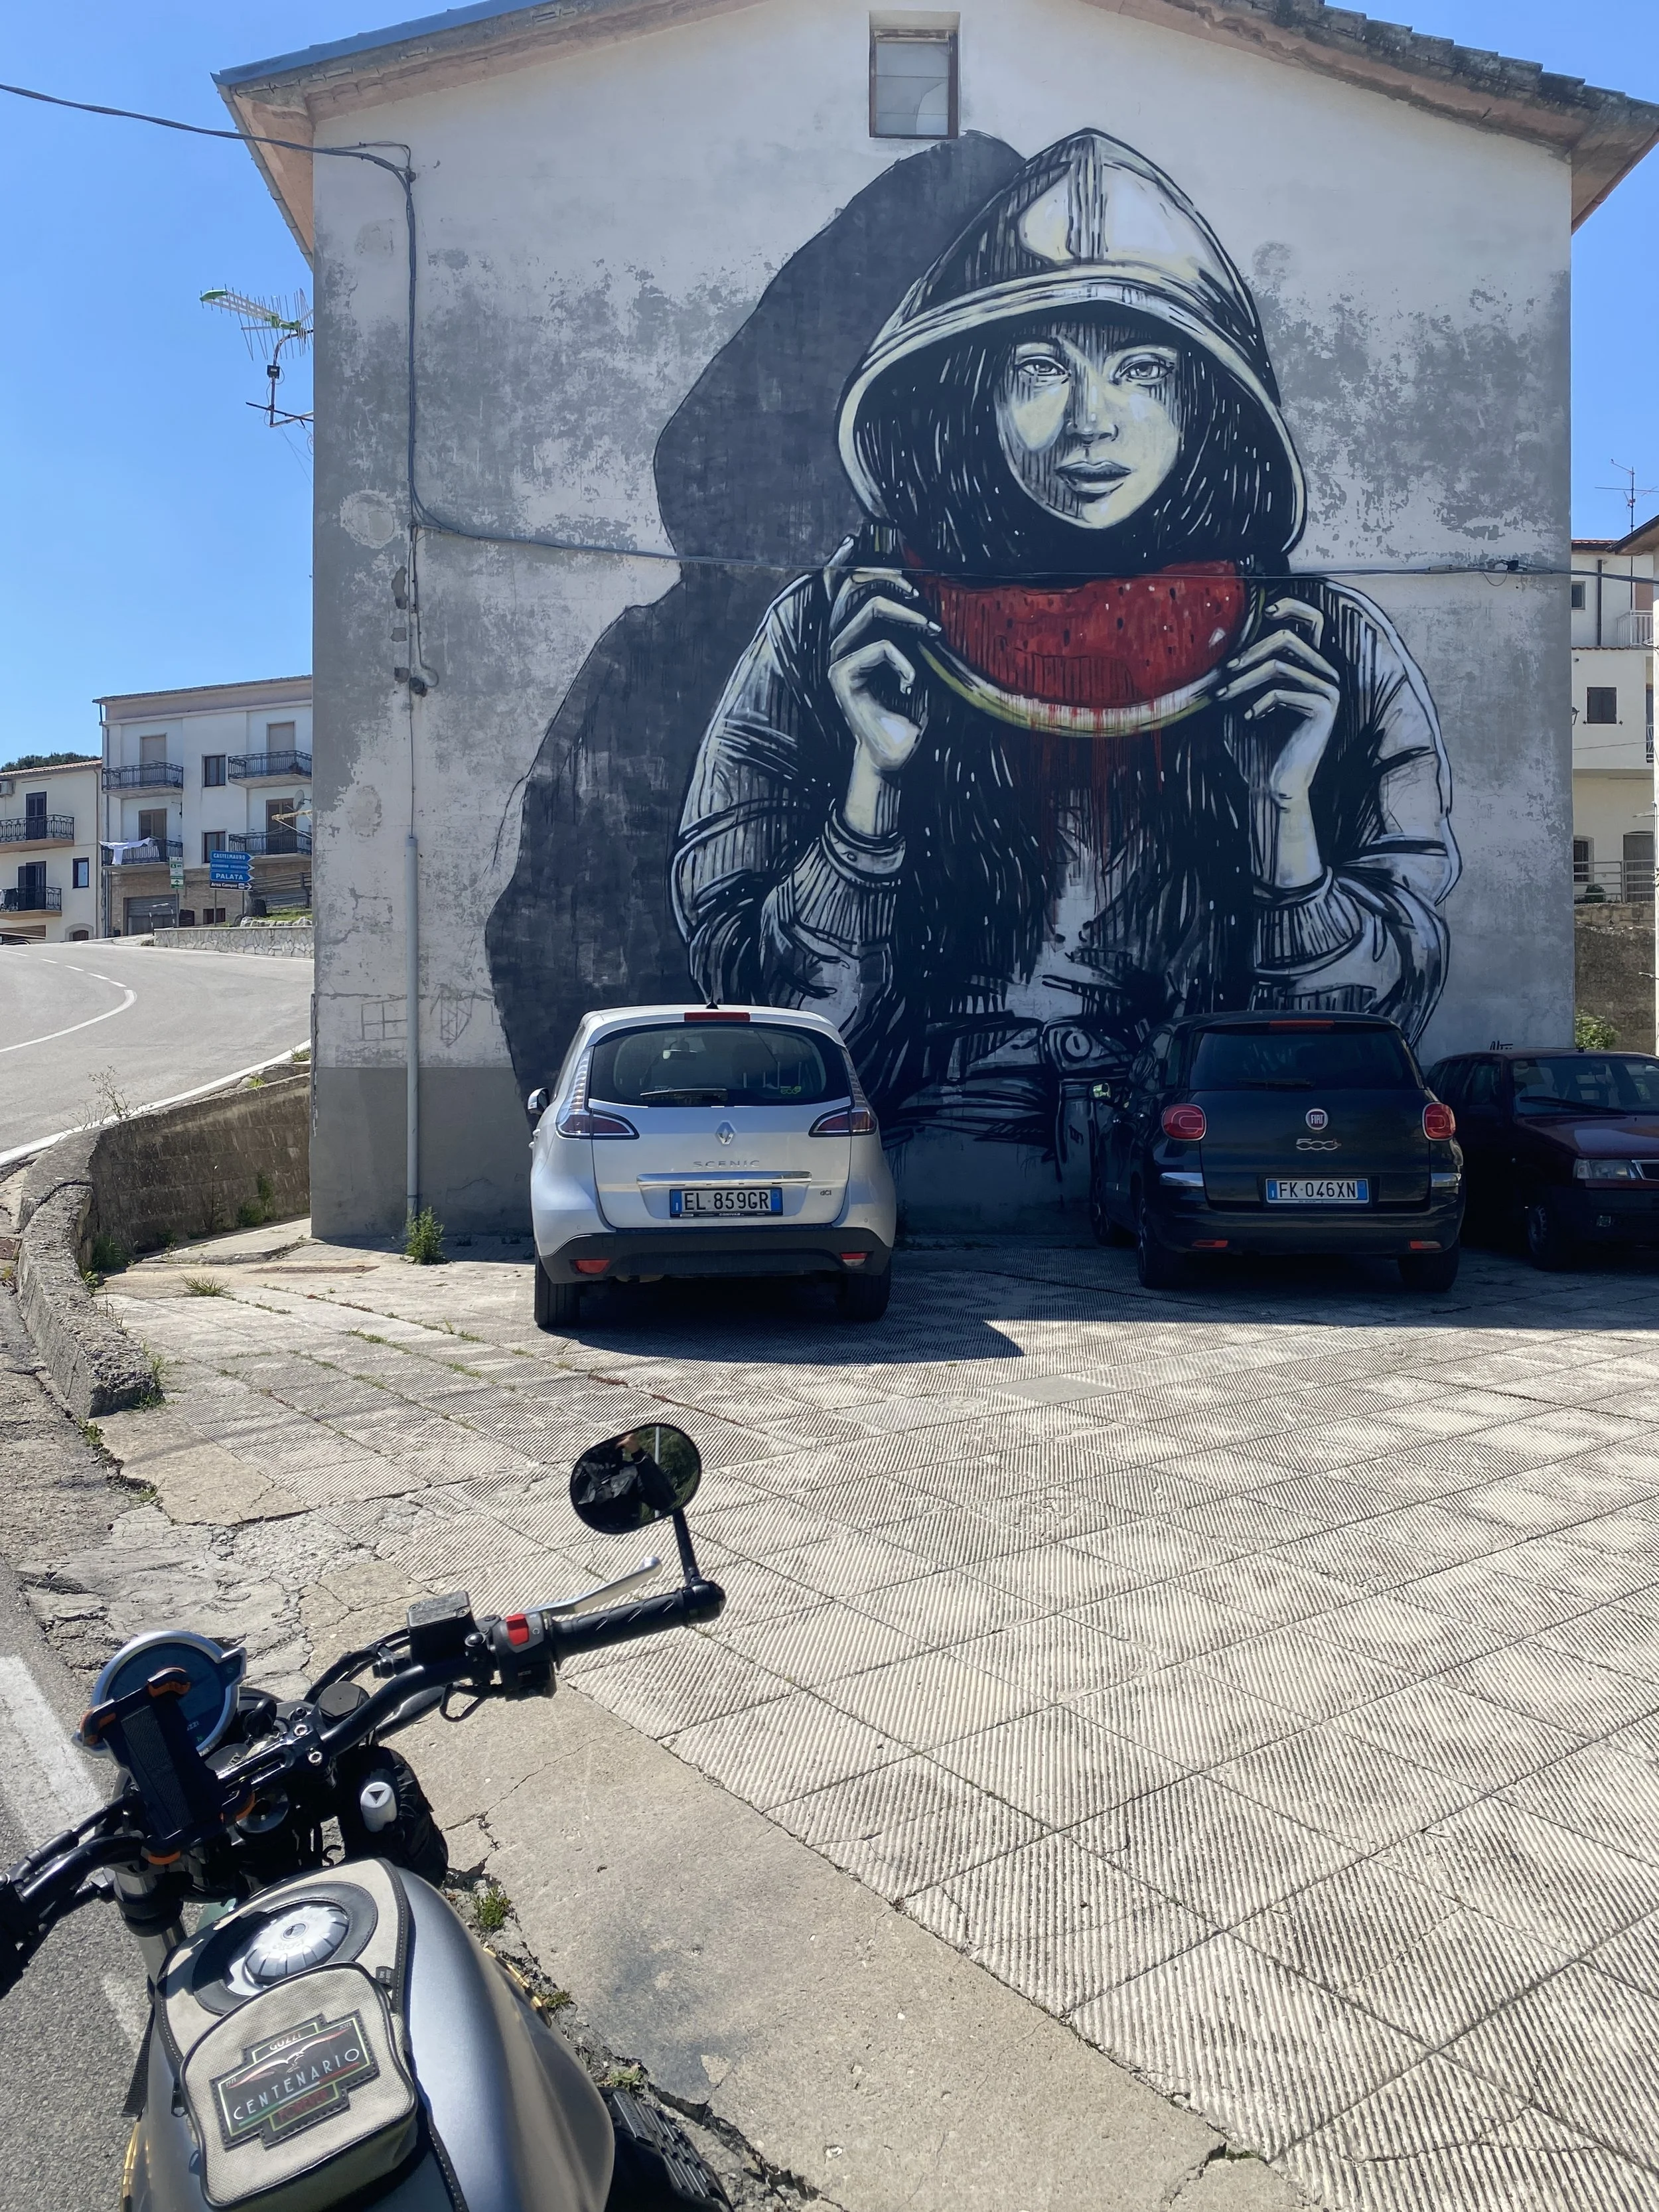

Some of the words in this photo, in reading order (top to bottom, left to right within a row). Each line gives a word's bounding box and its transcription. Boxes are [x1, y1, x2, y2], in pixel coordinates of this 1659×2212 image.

[1311, 1114, 1323, 1124] FIAT
[1279, 1182, 1298, 1198] FK
[1305, 1181, 1356, 1198] 046XN
[684, 1193, 706, 1211] EL
[714, 1192, 769, 1209] 859GR
[269, 2033, 302, 2051] GUZZI
[233, 2048, 360, 2120] CENTENARIO
[278, 2091, 328, 2122] FOREVER
